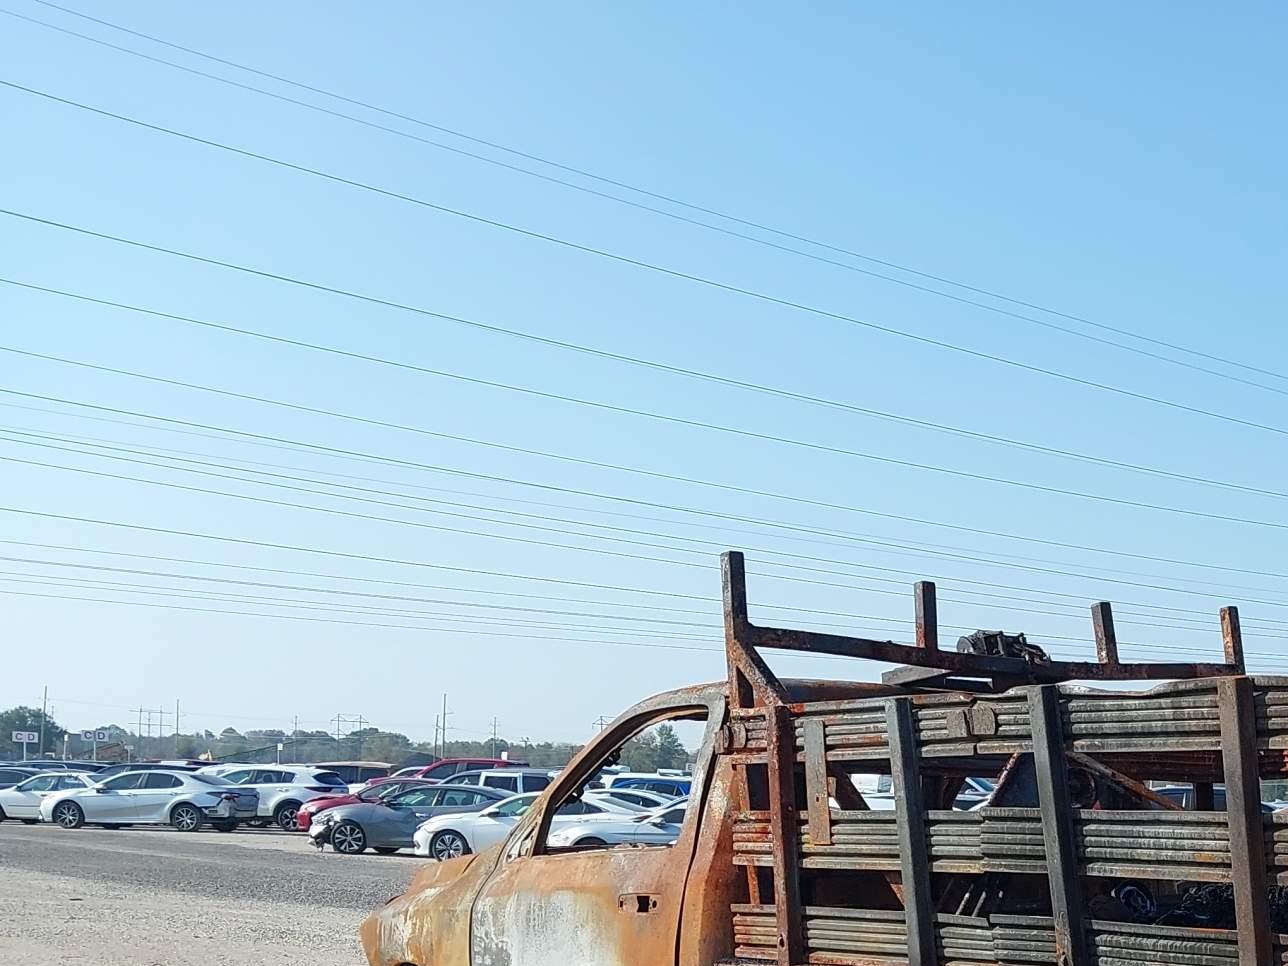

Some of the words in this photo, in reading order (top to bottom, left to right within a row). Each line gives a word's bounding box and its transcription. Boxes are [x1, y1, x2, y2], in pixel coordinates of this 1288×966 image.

[15, 732, 23, 740] C
[28, 733, 35, 741] D
[84, 731, 92, 739] C
[97, 731, 105, 740] D
